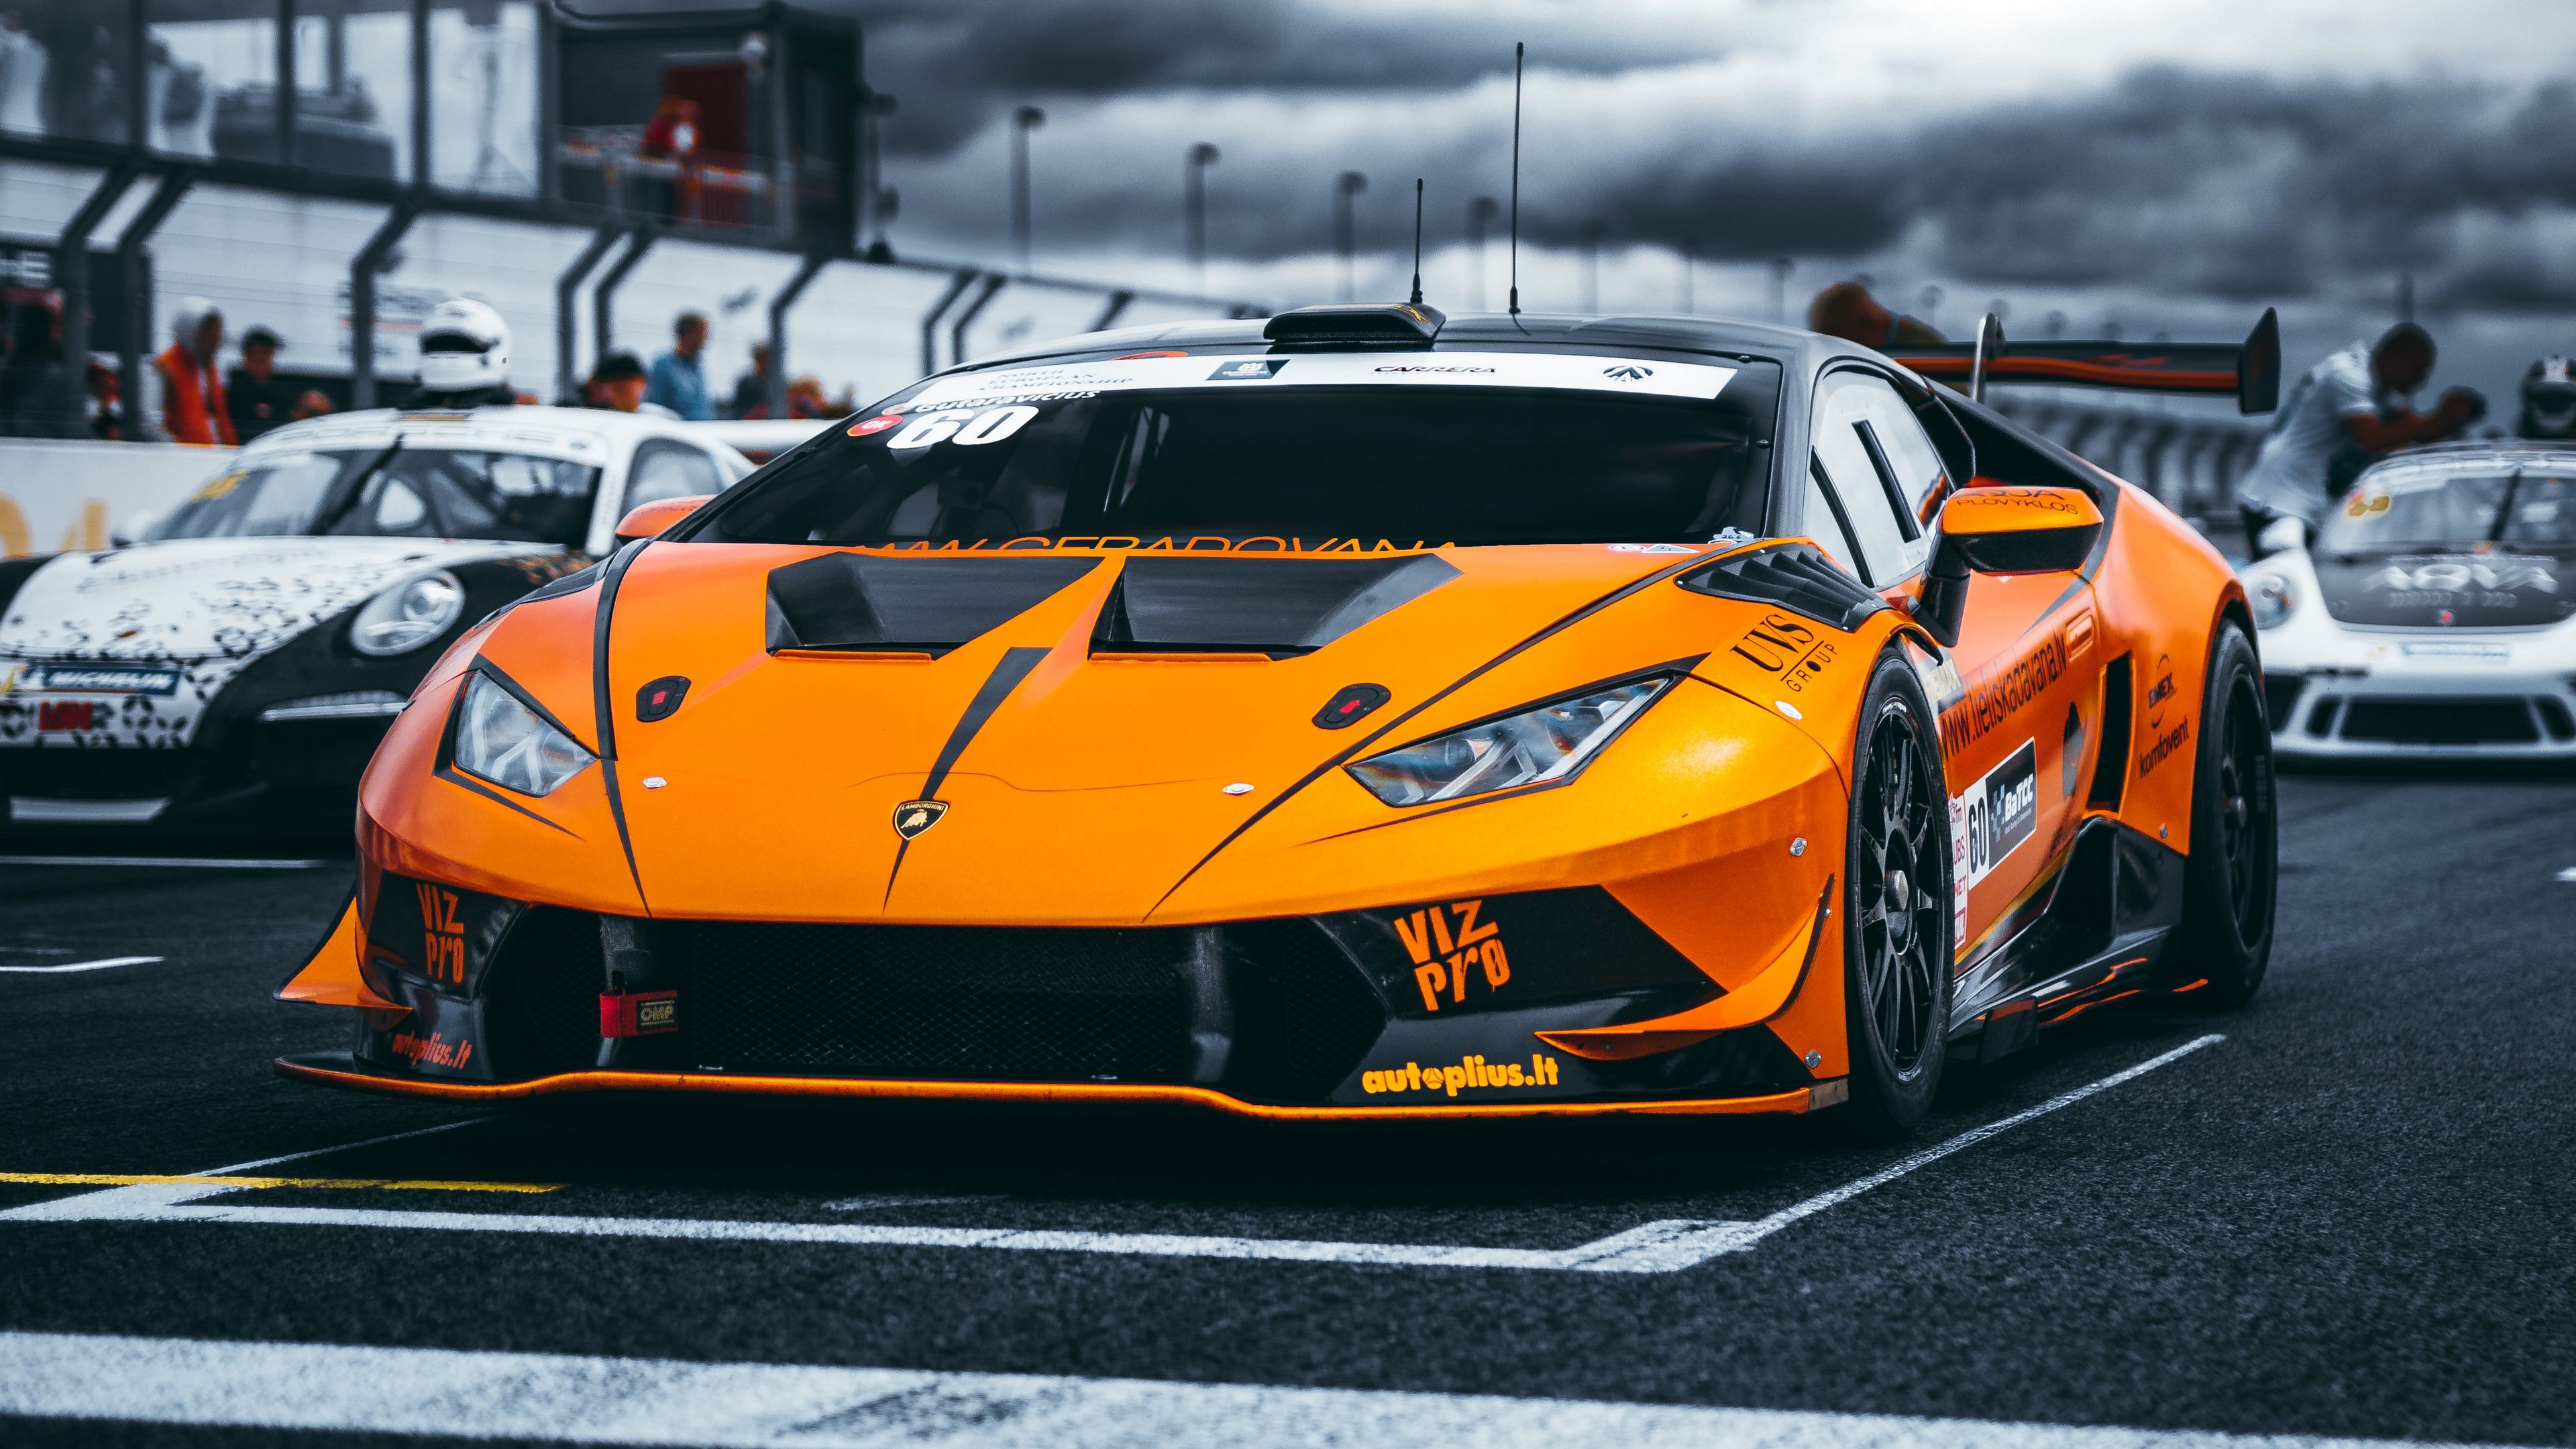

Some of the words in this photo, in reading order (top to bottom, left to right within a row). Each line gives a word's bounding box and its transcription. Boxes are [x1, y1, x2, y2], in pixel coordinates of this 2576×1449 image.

[886, 405, 1039, 449] 60
[1957, 498, 2078, 515] PLOVYKLOS
[1729, 612, 1814, 672] UVS
[1786, 643, 1837, 692] GROUP
[901, 803, 945, 811] LAMBORGHINI
[1968, 796, 1987, 874] 60
[415, 883, 464, 934] VIZ
[1393, 900, 1499, 965] VIZ
[641, 1005, 674, 1021] OMP
[1362, 1054, 1558, 1097] autoplius.lt
